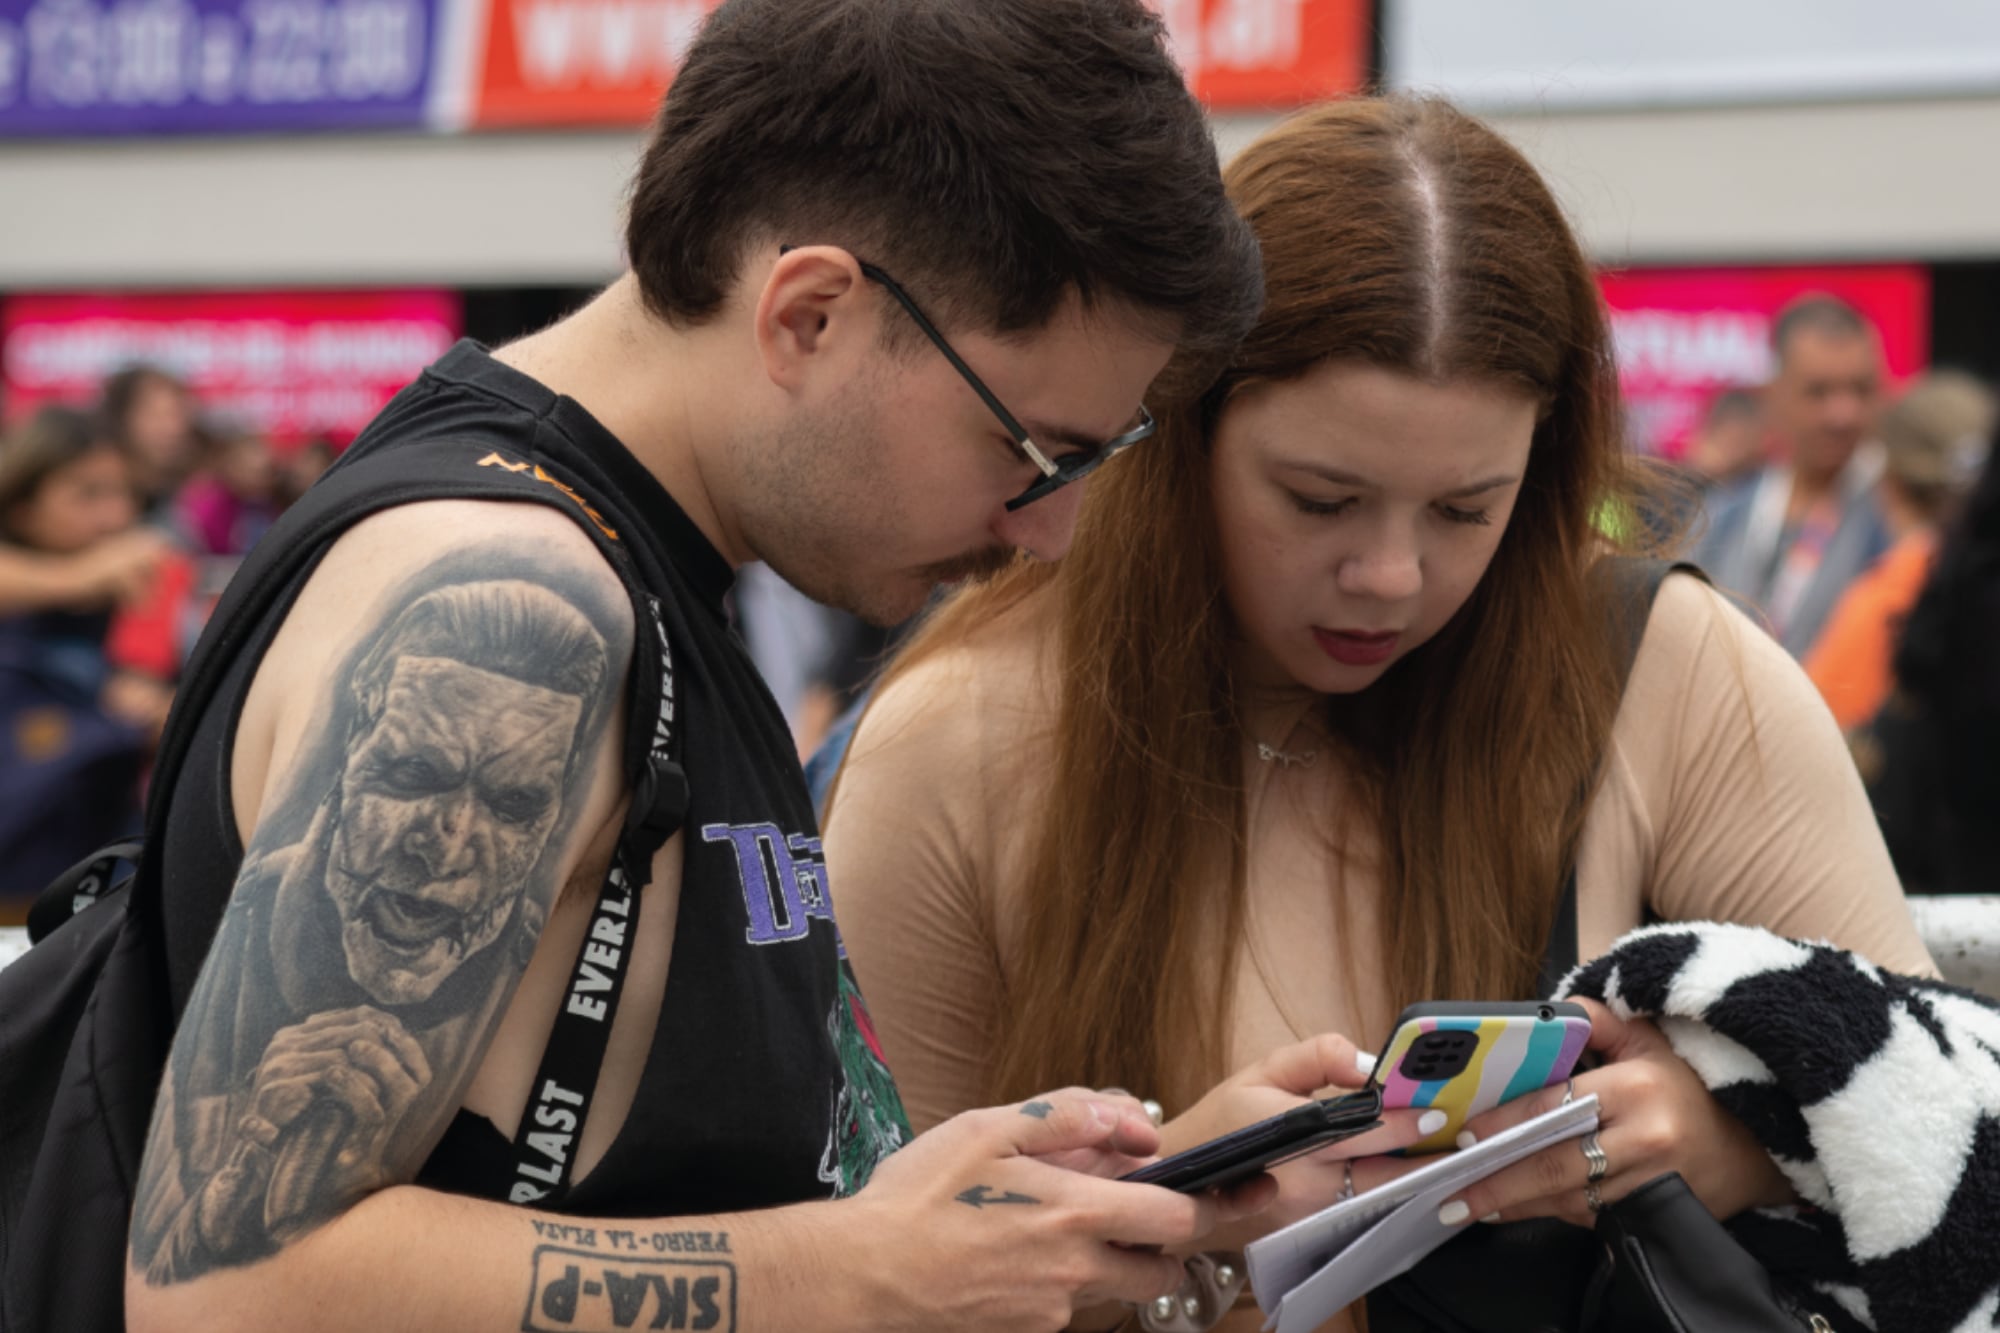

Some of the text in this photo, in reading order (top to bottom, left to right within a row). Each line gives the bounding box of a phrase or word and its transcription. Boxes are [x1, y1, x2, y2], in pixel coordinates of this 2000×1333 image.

[508, 0, 714, 92] www
[508, 1079, 584, 1203] RLAST
[531, 1219, 598, 1247] PLATA
[541, 1264, 721, 1331] SKA-P
